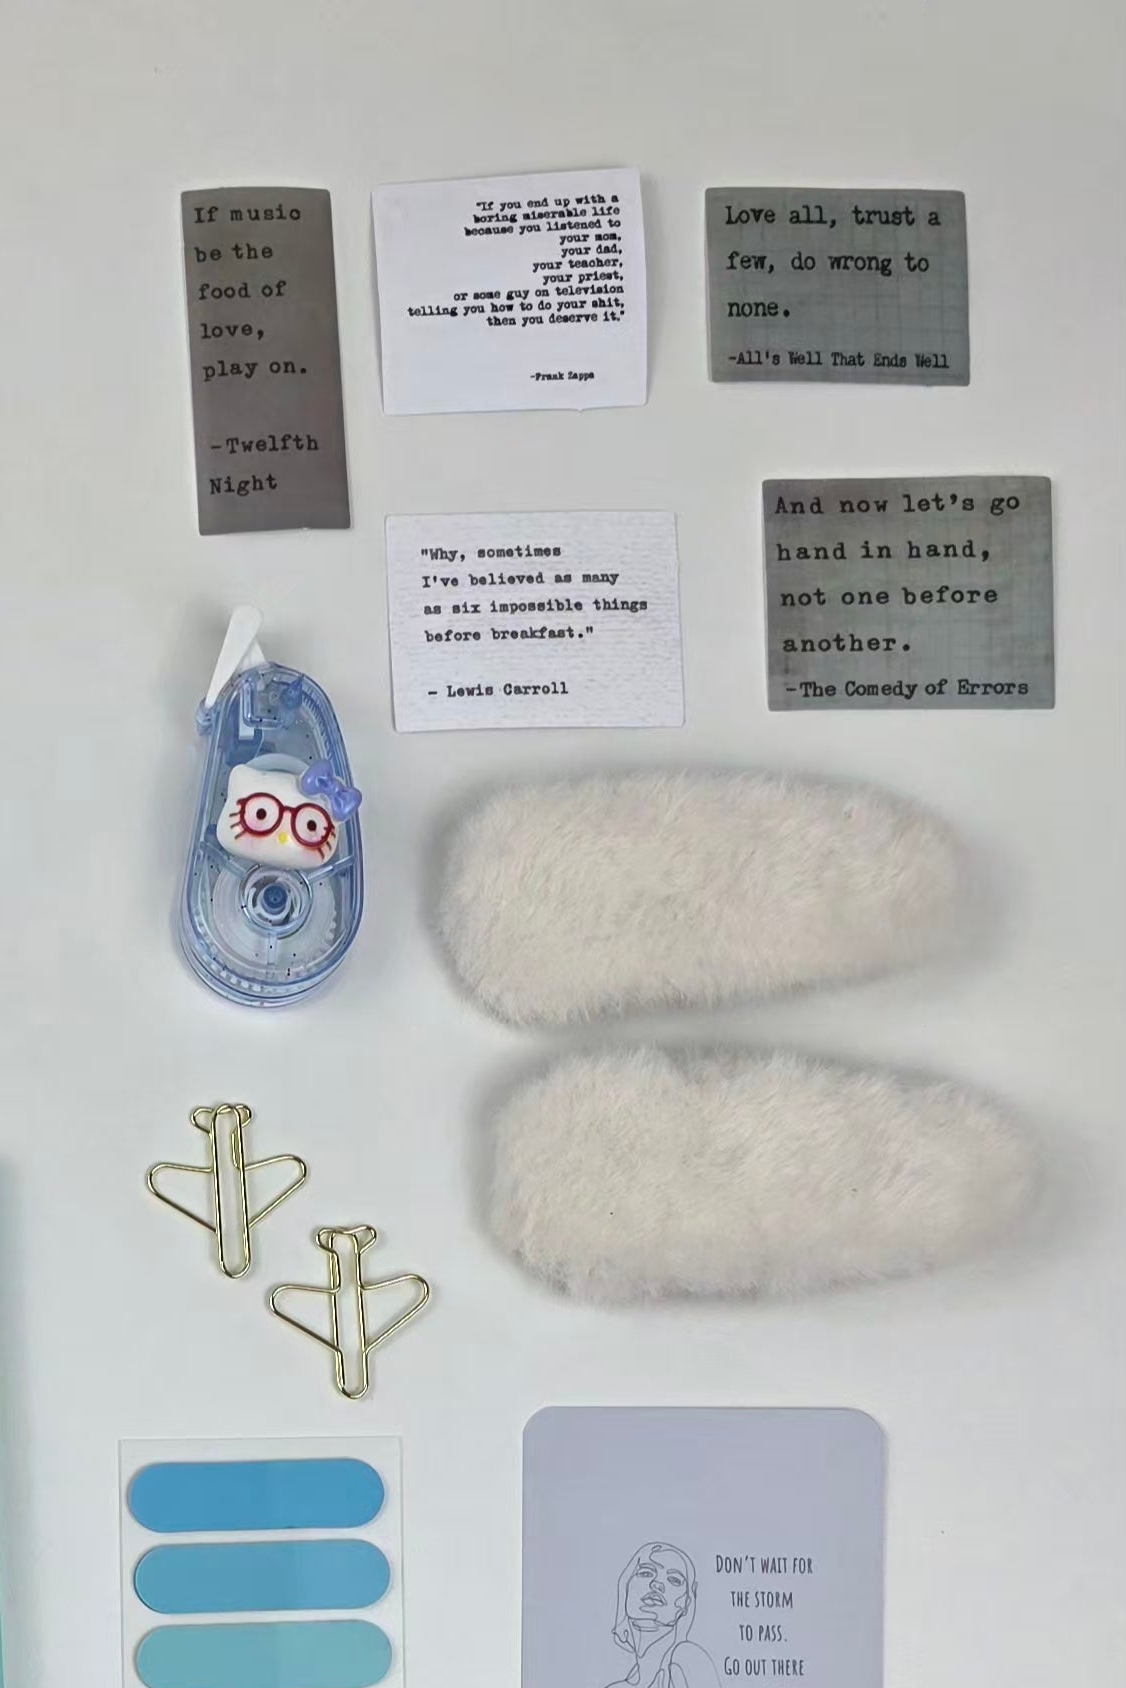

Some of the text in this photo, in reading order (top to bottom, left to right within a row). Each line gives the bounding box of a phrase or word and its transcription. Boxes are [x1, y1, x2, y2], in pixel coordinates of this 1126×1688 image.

[500, 202, 521, 212] you
[527, 198, 548, 208] end
[555, 198, 570, 208] up
[575, 194, 605, 204] with
[194, 205, 301, 223] If music
[726, 206, 941, 228] Love all, trust a
[196, 244, 273, 262] be the
[726, 252, 929, 276] few, do wrong to
[199, 281, 286, 300] food of
[407, 297, 624, 317] telling you how to do your shit,
[728, 302, 790, 317] none.
[201, 323, 265, 340] love,
[789, 352, 822, 364] Well
[831, 352, 864, 367] That
[873, 353, 906, 368] Ends
[916, 354, 949, 368] Well
[203, 359, 307, 382] play on.
[568, 371, 594, 381] Zappa
[210, 473, 278, 496] Night
[775, 494, 1020, 516] And now let's go
[421, 545, 561, 562] "Why, sometimes
[777, 540, 989, 562] hand in hand,
[422, 572, 619, 588] I've believed as many
[781, 585, 998, 607] not one before
[424, 598, 648, 615] as six impossible things
[425, 626, 593, 642] before breakfast."
[783, 634, 911, 652] another.
[447, 682, 568, 698] Lewis Carroll
[845, 680, 917, 700] Comedy
[925, 679, 948, 695] of
[957, 679, 1028, 695] Errors
[761, 1557, 787, 1574] WAIT
[793, 1557, 813, 1574] FOR
[731, 1591, 793, 1608] THE STORM
[740, 1624, 787, 1642] TO PASS.
[724, 1657, 804, 1676] GO OUT THERE
